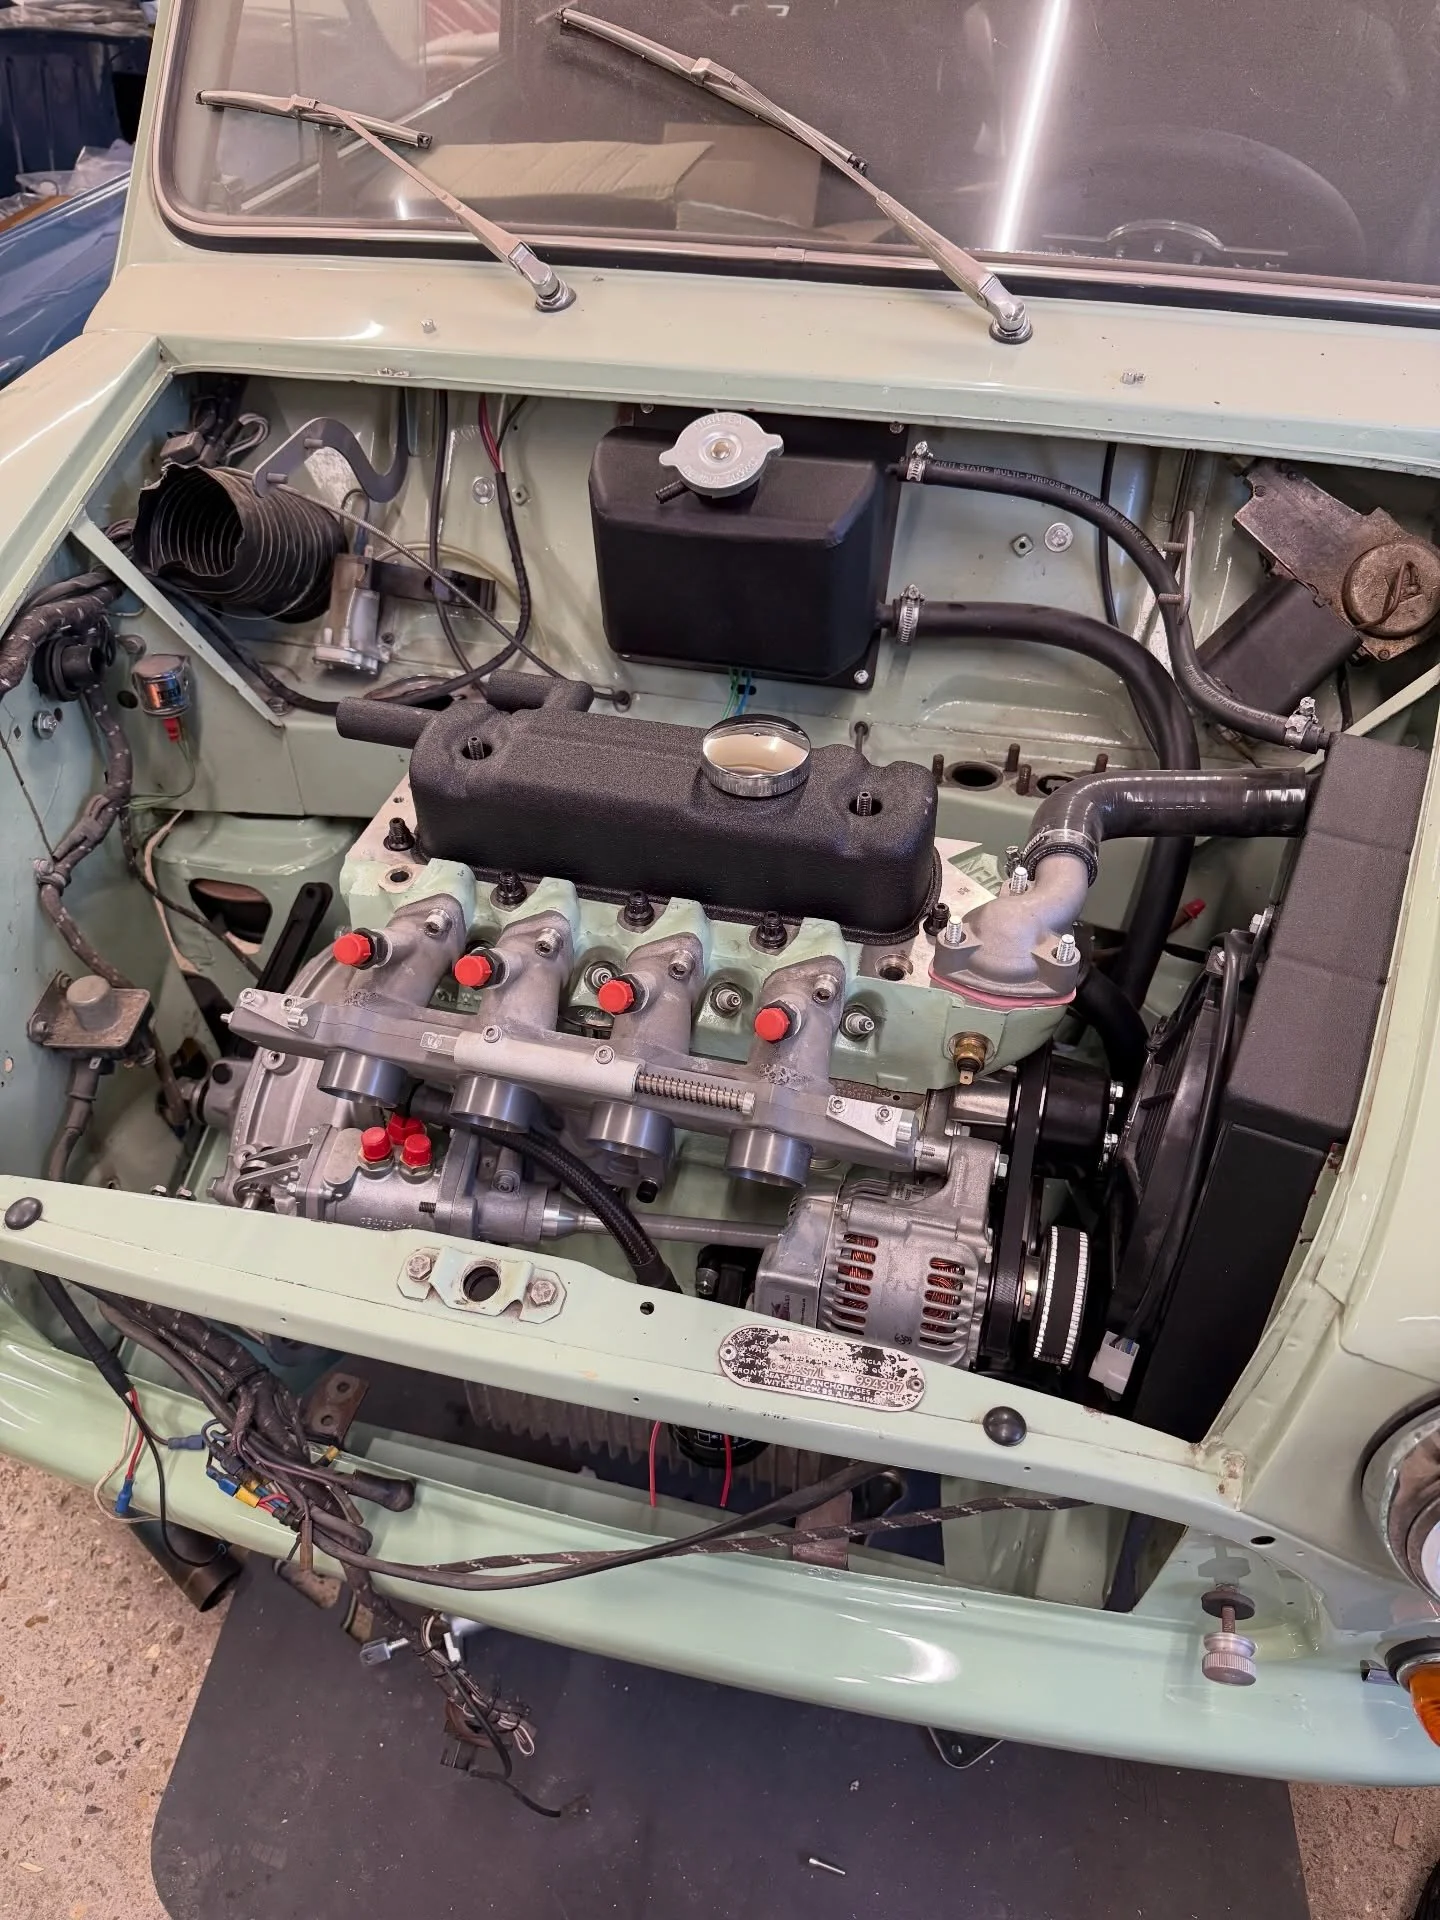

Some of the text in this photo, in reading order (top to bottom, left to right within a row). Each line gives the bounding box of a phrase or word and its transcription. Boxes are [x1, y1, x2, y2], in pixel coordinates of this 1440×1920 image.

[959, 464, 990, 473] STATIC
[763, 1377, 788, 1389] WITH
[810, 1379, 872, 1396] ANCHORAGES
[855, 1375, 905, 1394] 994907
